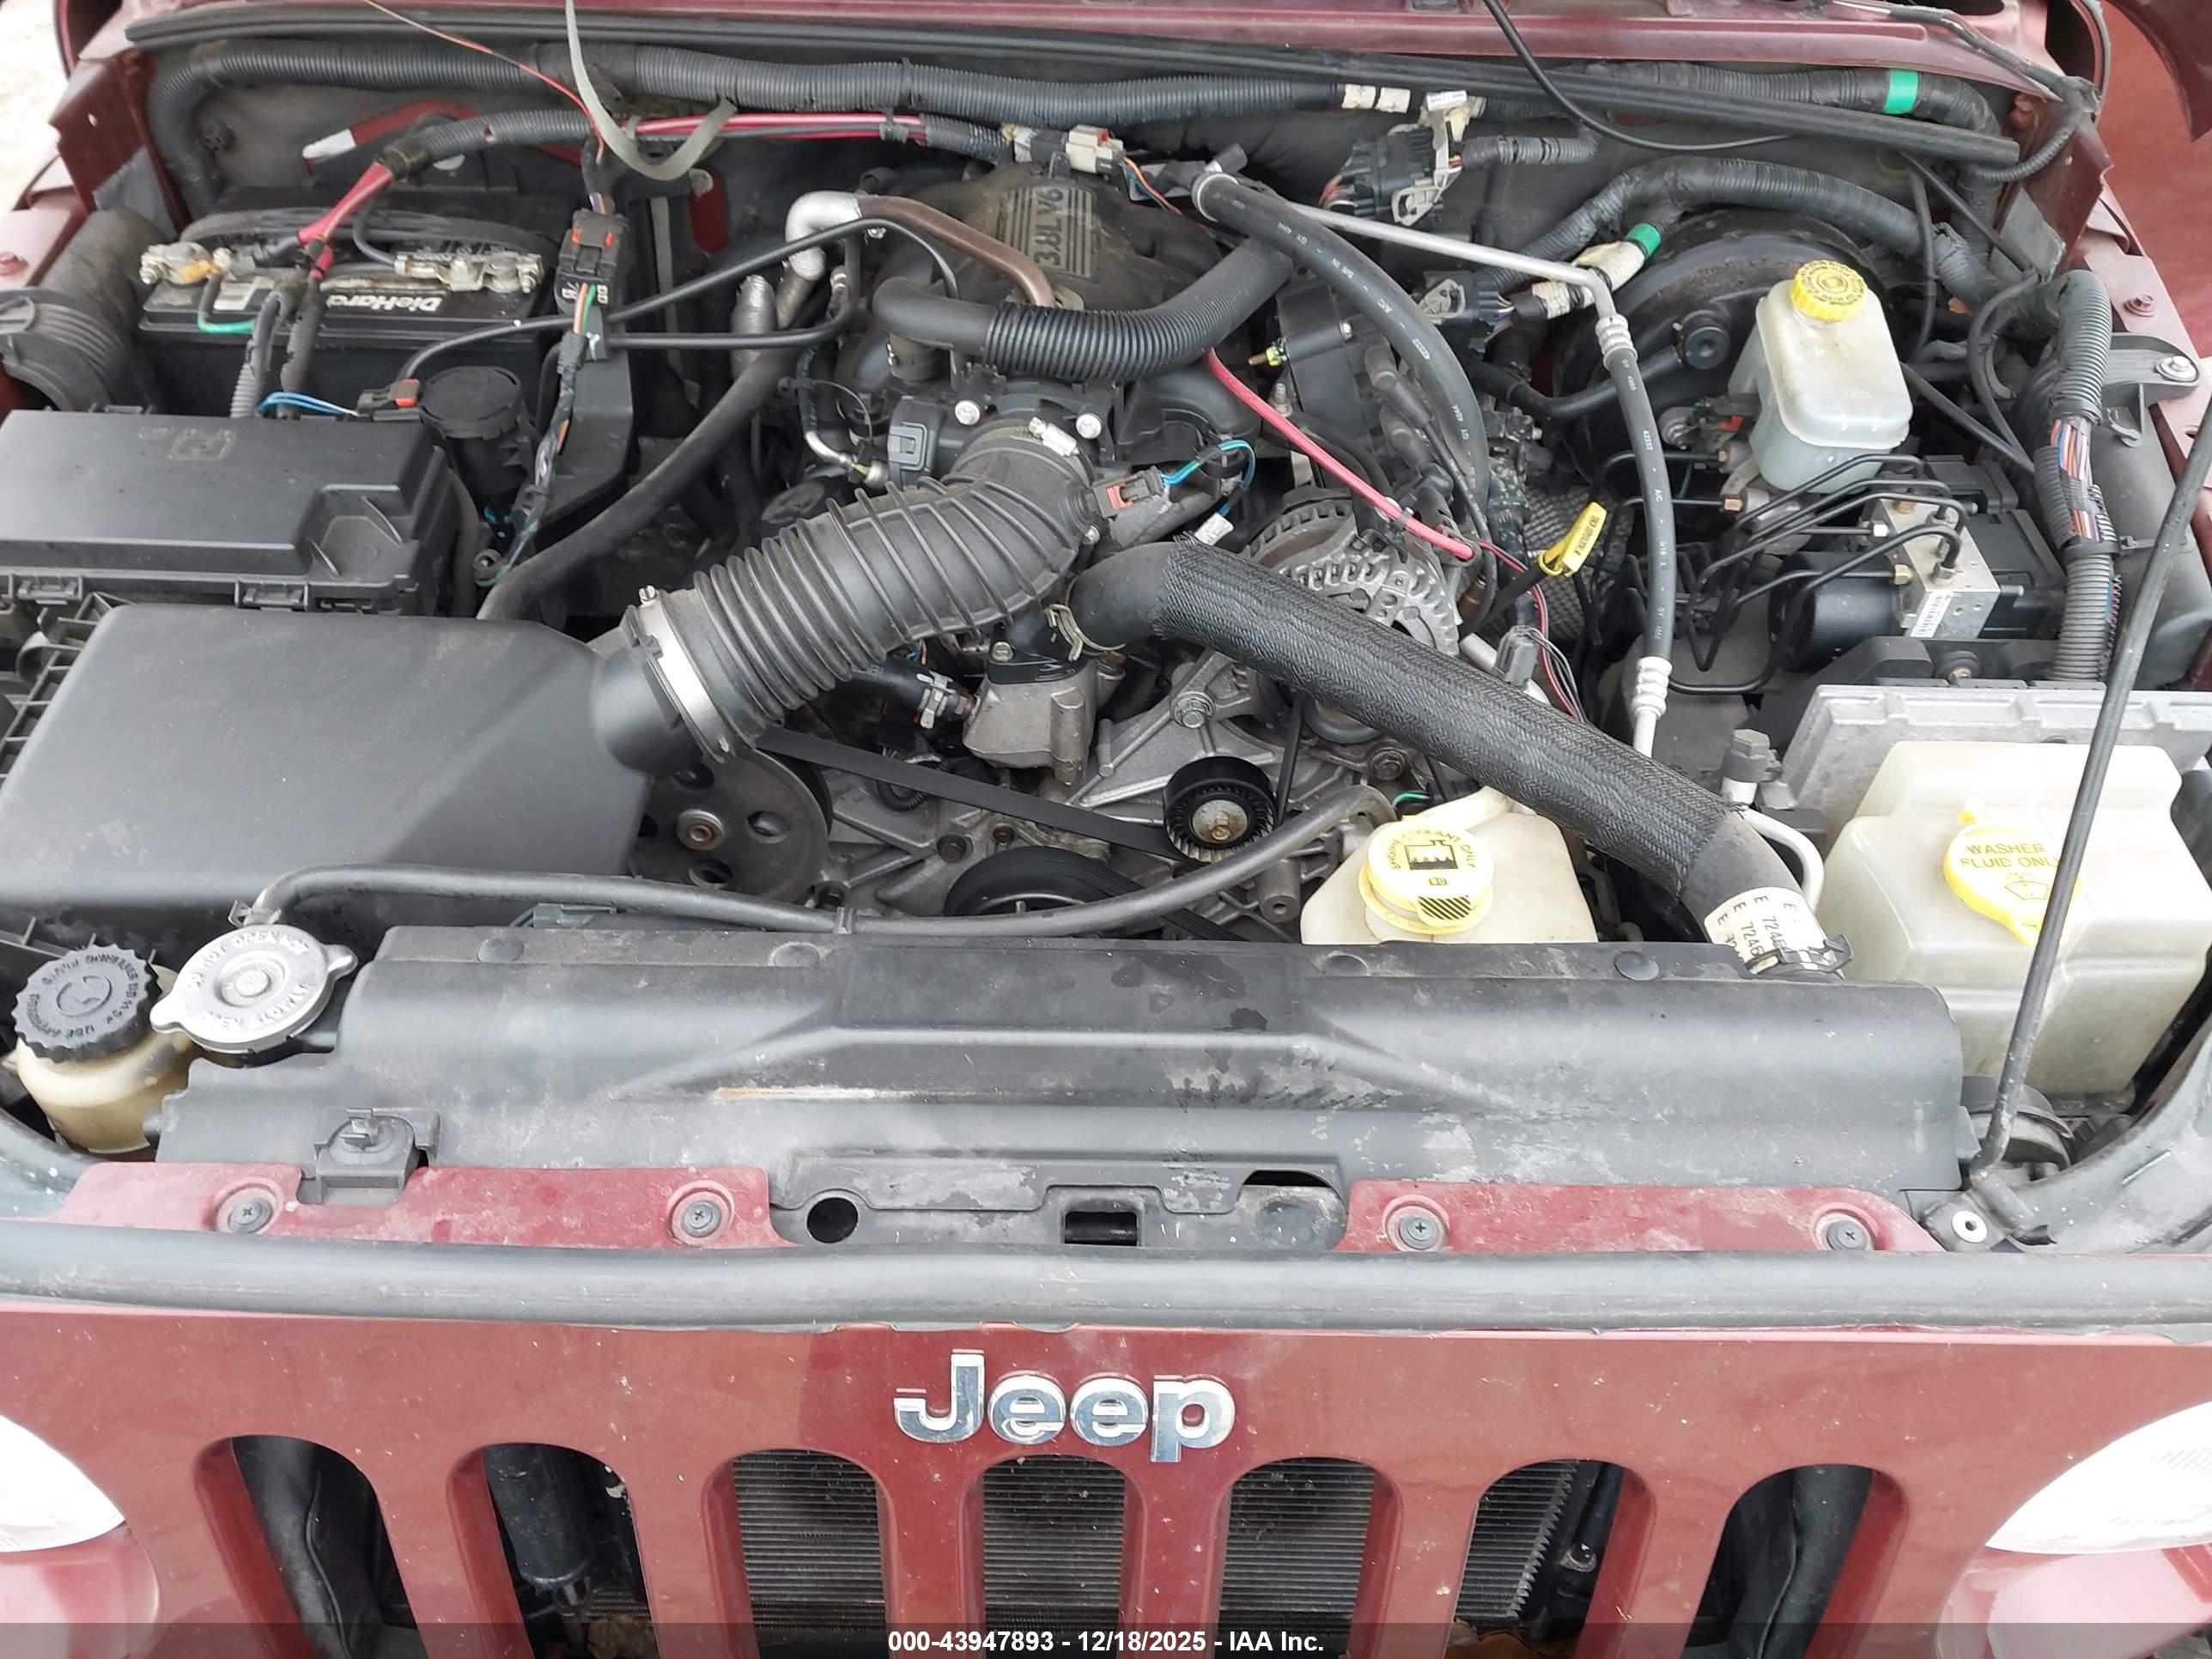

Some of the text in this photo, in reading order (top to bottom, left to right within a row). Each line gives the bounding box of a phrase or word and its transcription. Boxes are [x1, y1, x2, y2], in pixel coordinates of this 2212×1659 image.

[1036, 188, 1064, 216] V6
[326, 295, 442, 312] DieHard
[1966, 842, 2045, 855] WASHER
[1960, 856, 2012, 869] FLUID
[1753, 895, 1770, 905] E
[1733, 901, 1747, 914] E
[1717, 912, 1729, 926] E
[231, 930, 281, 949] OPEN
[893, 1350, 1236, 1462] Jeep
